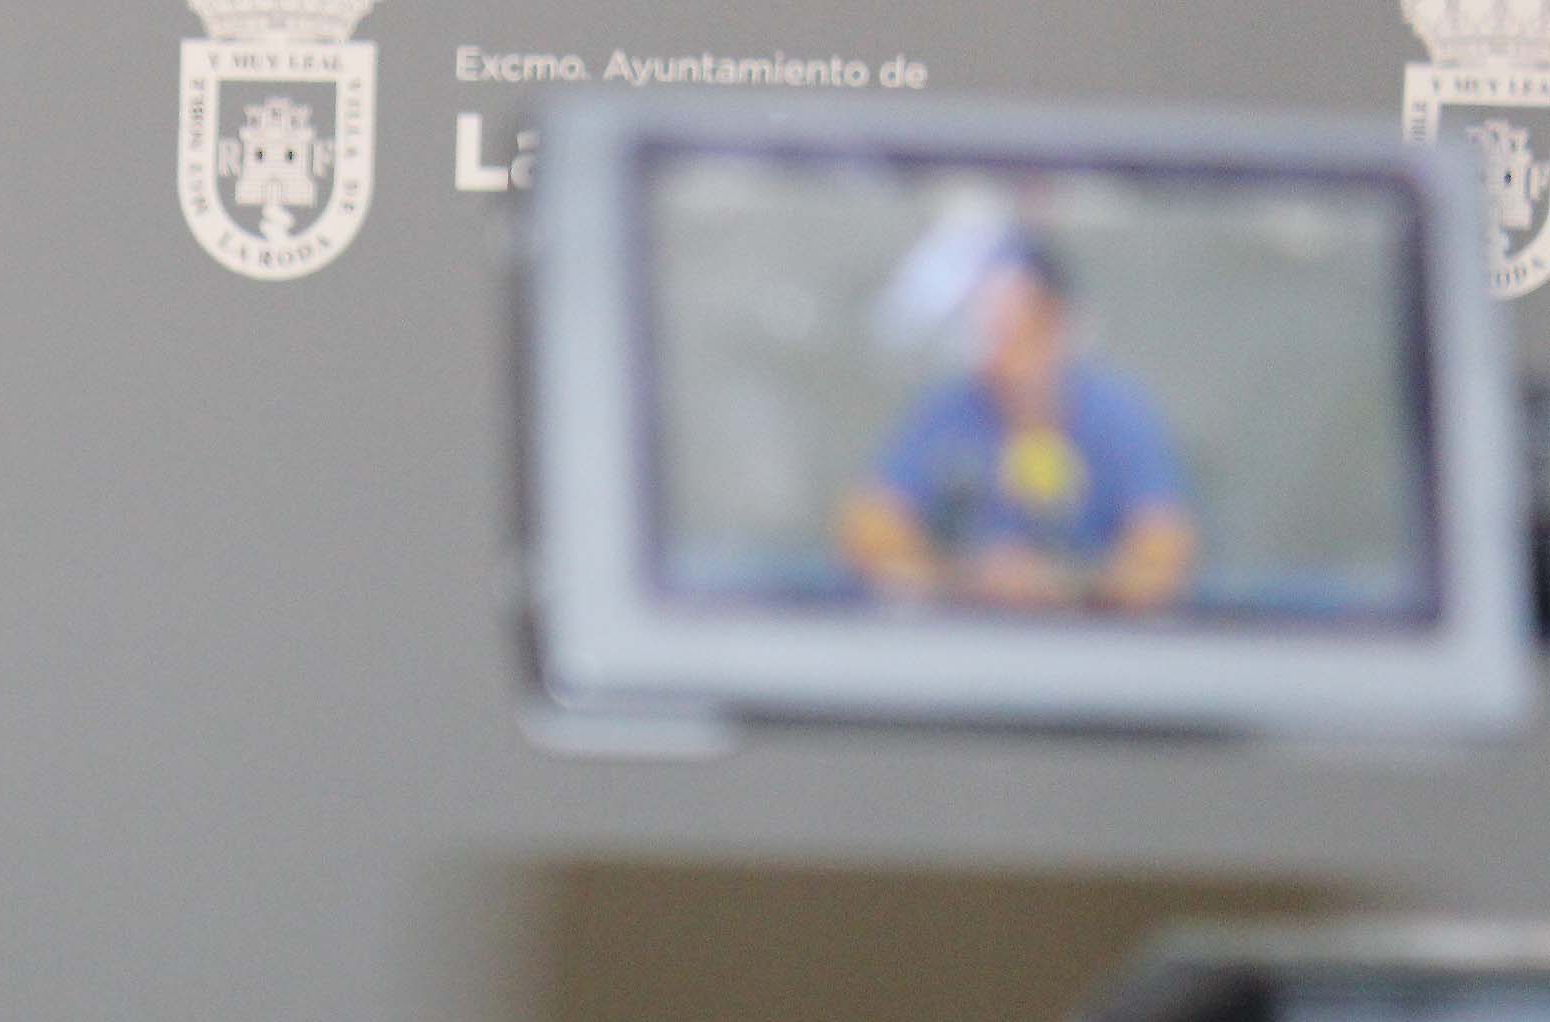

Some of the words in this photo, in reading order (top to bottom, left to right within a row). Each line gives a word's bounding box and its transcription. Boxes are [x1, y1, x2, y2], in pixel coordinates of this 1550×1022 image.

[455, 44, 589, 82] Excmo.
[602, 48, 870, 88] Ayuntamiento
[879, 53, 930, 89] de
[1508, 78, 1550, 97] LEA
